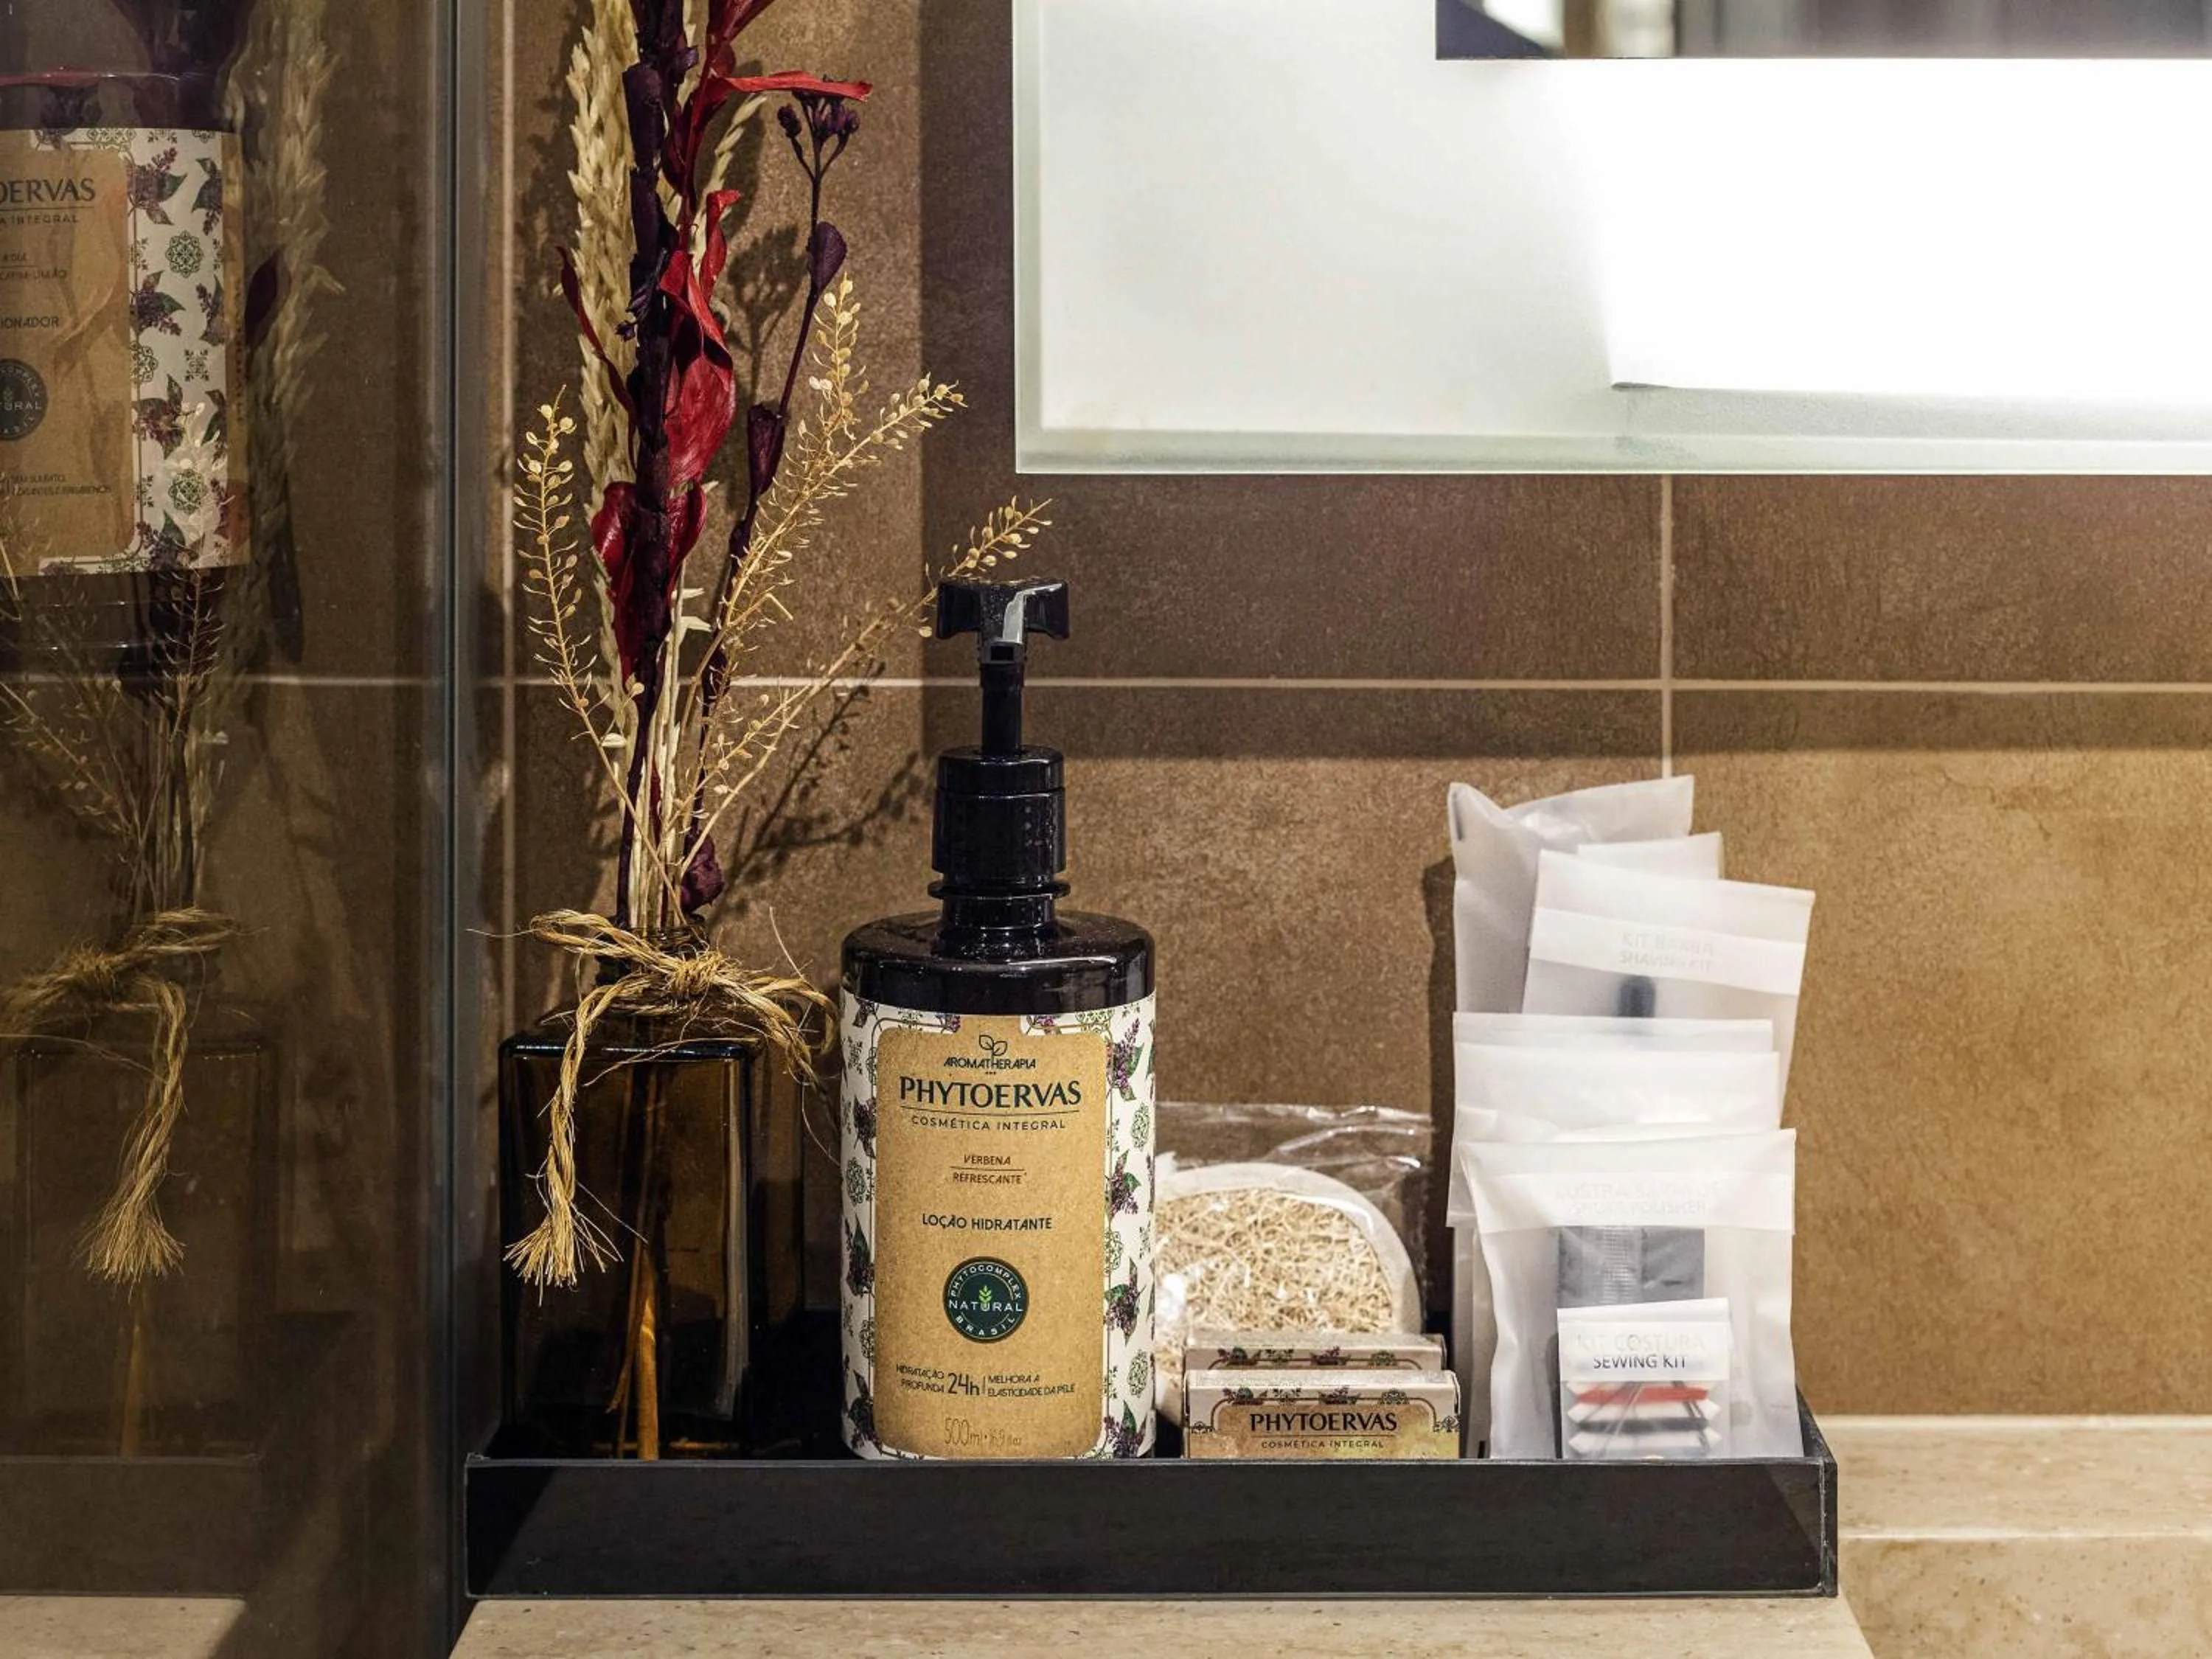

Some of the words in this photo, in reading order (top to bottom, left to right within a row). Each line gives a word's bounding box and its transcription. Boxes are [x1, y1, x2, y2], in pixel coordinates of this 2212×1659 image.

[13, 214, 79, 224] INTEGRAL
[0, 401, 42, 411] URAL
[944, 1057, 1036, 1069] AROMATHERAPIA
[900, 1076, 1082, 1107] PHYTOERVAS
[911, 1116, 990, 1130] COSMÉTICA
[997, 1120, 1065, 1130] INTEGRAL
[964, 1154, 1011, 1165] VERBENA
[952, 1173, 1022, 1184] REFRESCANTE
[922, 1213, 967, 1229] LOÇÃO
[971, 1217, 1052, 1231] HIDRATANTE
[950, 1265, 1021, 1300] PHYTOCOMPLEX
[949, 1299, 1024, 1312] NATURAL
[956, 1315, 1015, 1335] BRASIL
[1593, 1353, 1658, 1369] SEWING
[1663, 1354, 1688, 1369] KIT
[896, 1363, 945, 1380] HIDRATAÇÃO
[900, 1378, 945, 1393] PROFUNDA
[947, 1372, 980, 1396] 24h
[988, 1374, 1032, 1384] MELHORA
[1033, 1374, 1040, 1382] A
[988, 1386, 1043, 1397] ELASTICIDADE
[1043, 1386, 1056, 1395] DA
[1057, 1383, 1076, 1394] PELE
[1250, 1412, 1397, 1432] PHYTOERVAS
[1262, 1439, 1325, 1449] COSMÉTICA
[1329, 1440, 1385, 1449] INTEGRAL
